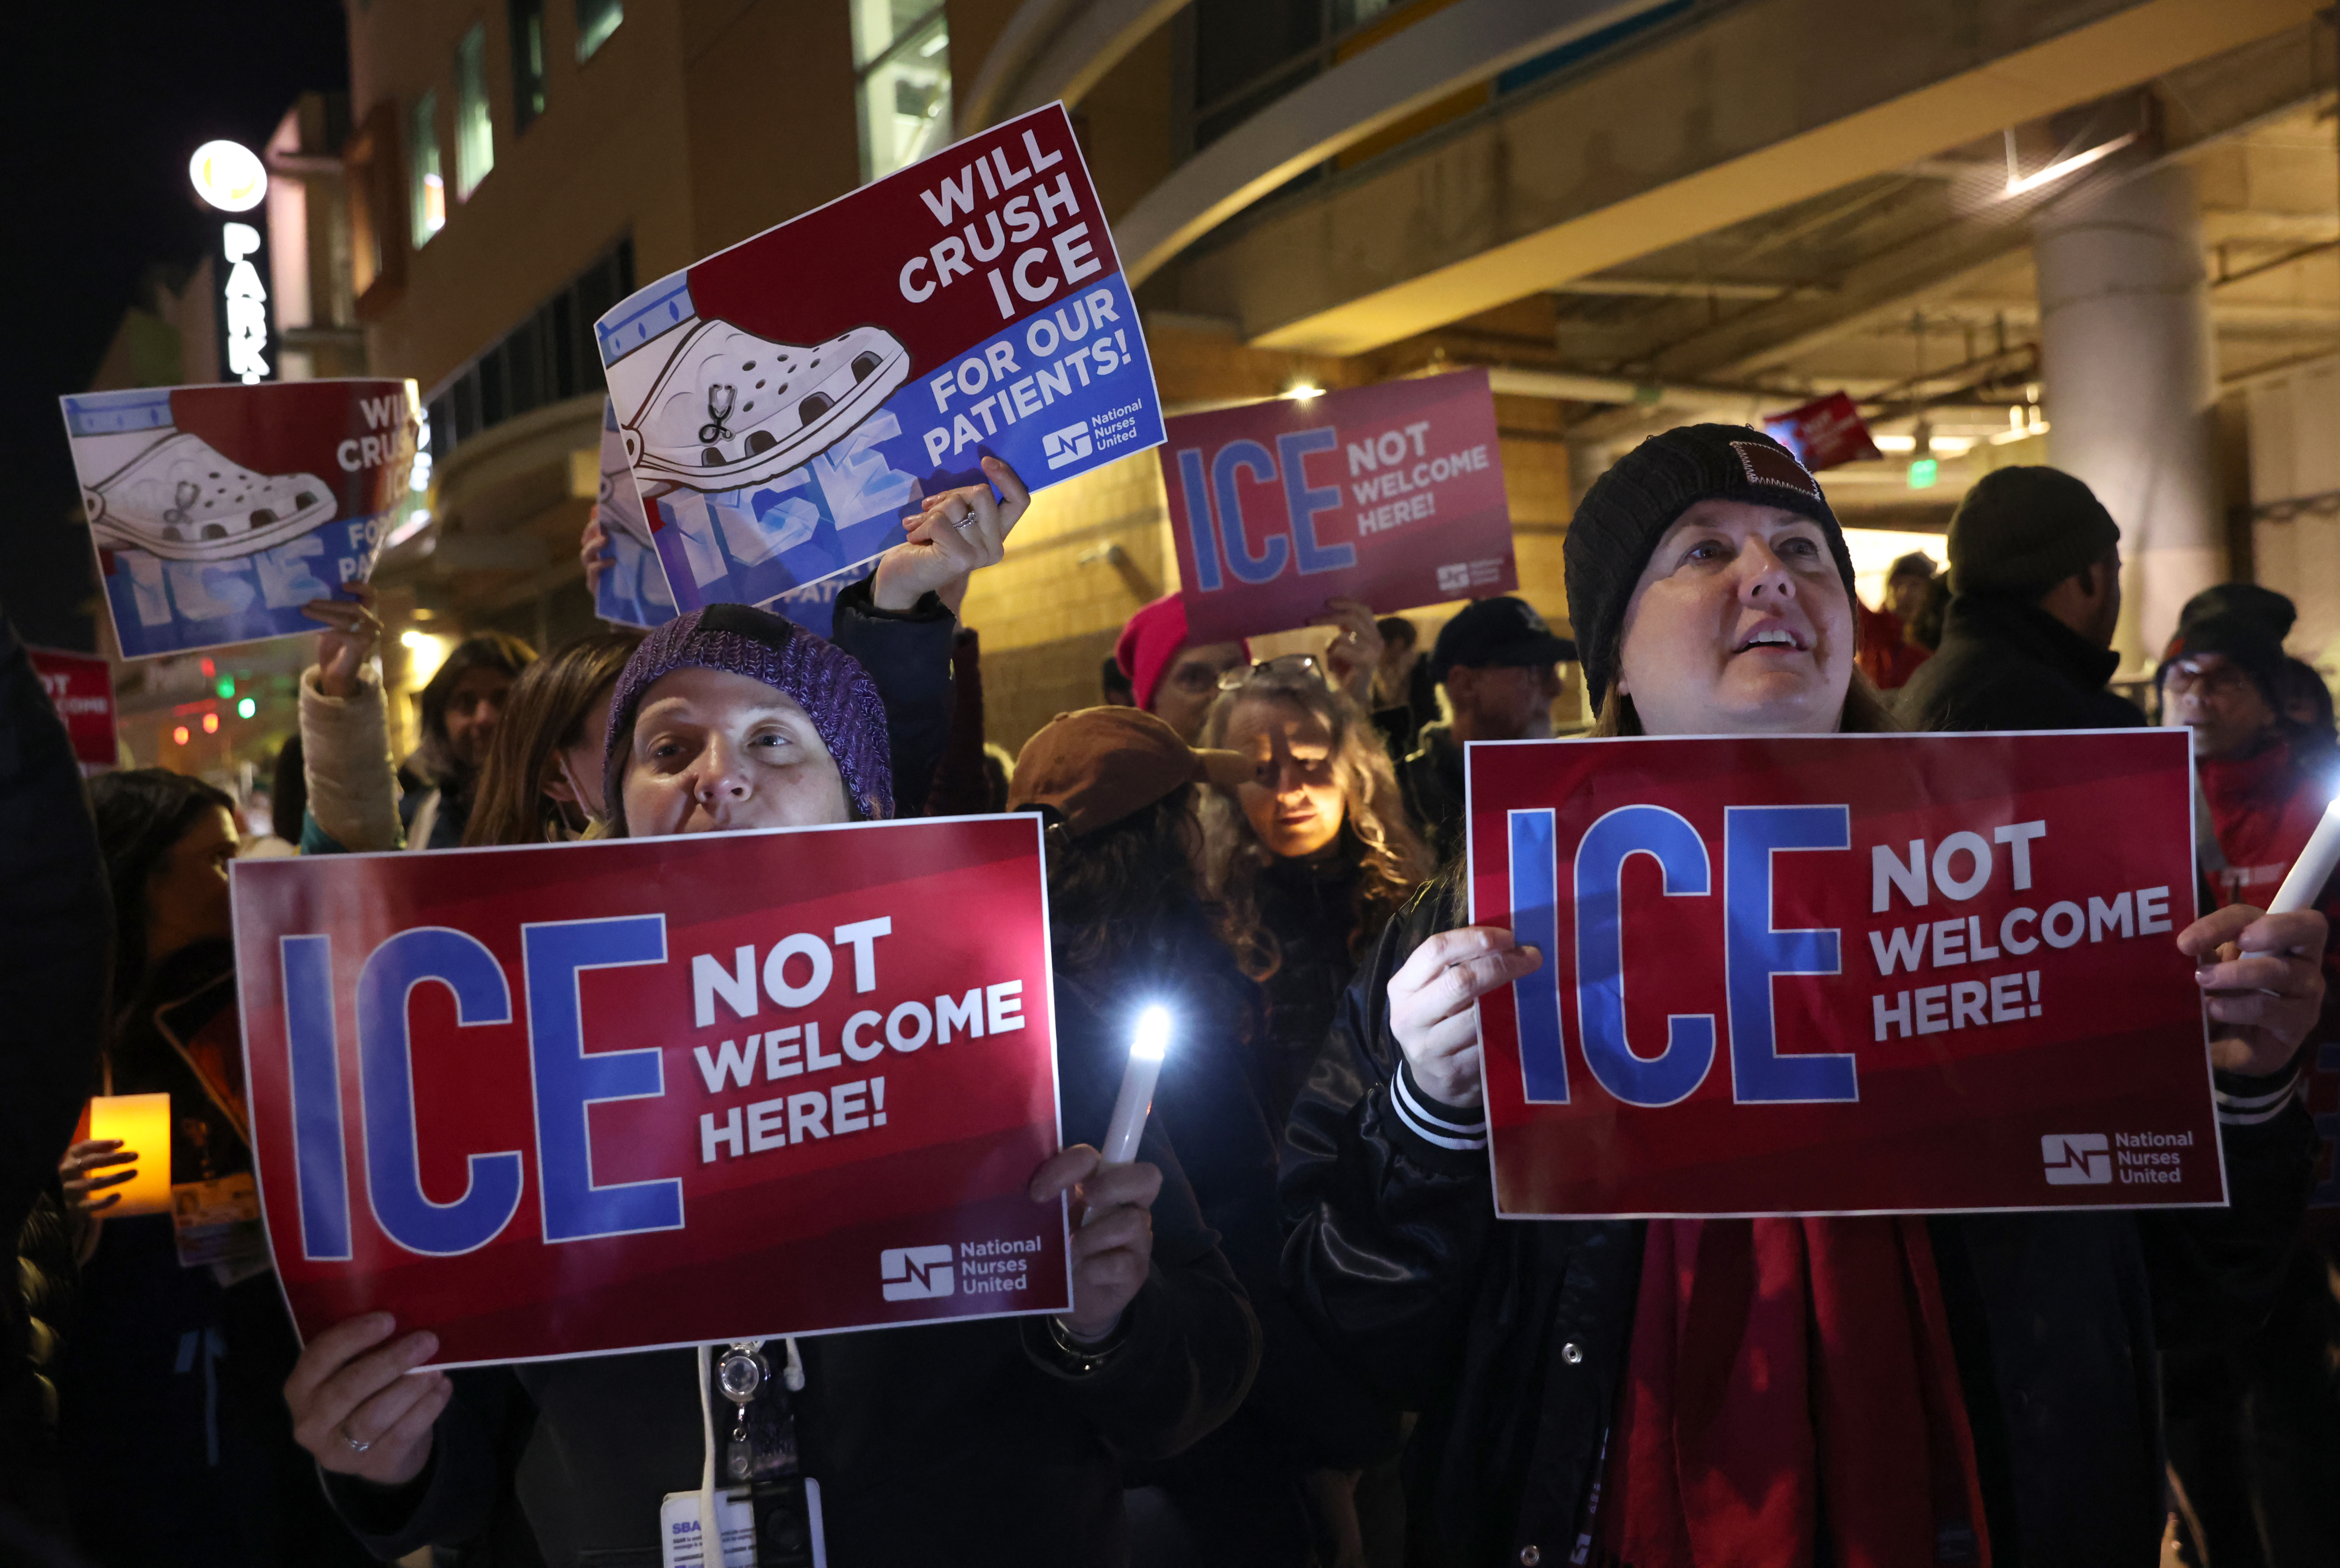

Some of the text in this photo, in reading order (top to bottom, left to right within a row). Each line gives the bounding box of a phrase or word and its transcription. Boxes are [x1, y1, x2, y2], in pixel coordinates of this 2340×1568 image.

[920, 129, 1063, 227] WILL
[899, 171, 1080, 303] CRUSH
[987, 221, 1102, 319] ICE
[930, 289, 1120, 414] FOR OUR
[923, 328, 1131, 467] PATIENTS!
[1092, 398, 1142, 427] National
[1094, 417, 1135, 439] Nurses
[1097, 426, 1137, 450] United
[1347, 420, 1431, 477] NOT
[1352, 444, 1490, 506] WELCOME
[1176, 425, 1357, 592] ICE
[1356, 492, 1436, 536] HERE!
[1871, 819, 2046, 913] NOT
[1507, 804, 1859, 1108] ICE
[1868, 885, 2172, 976] WELCOME
[691, 915, 892, 1028] NOT
[1872, 970, 2042, 1042] HERE!
[693, 979, 1025, 1094] WELCOME
[279, 913, 685, 1261] ICE
[699, 1076, 887, 1164] HERE!
[2115, 1131, 2193, 1148] National
[2117, 1150, 2181, 1165] Nurses
[2119, 1168, 2181, 1183] United
[960, 1236, 1041, 1258] National
[962, 1259, 1027, 1276] Nurses
[963, 1275, 1027, 1294] United
